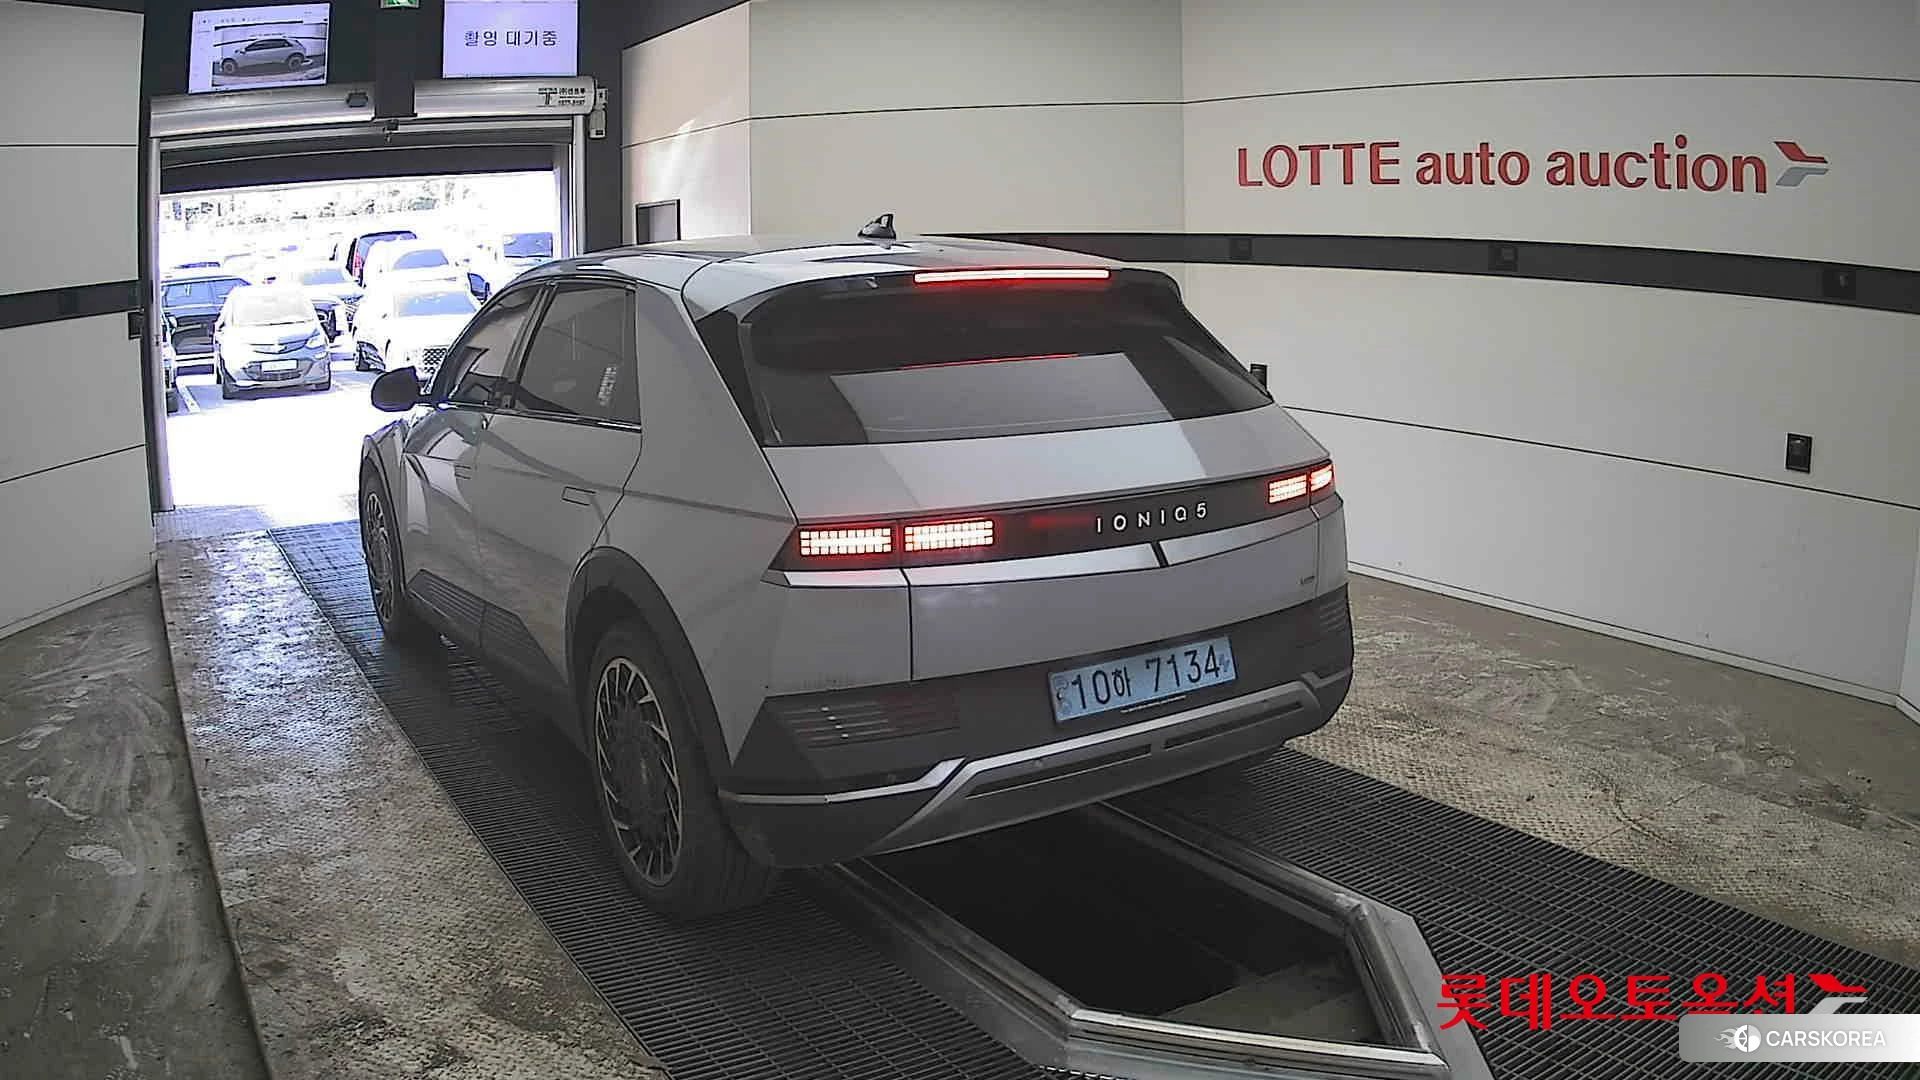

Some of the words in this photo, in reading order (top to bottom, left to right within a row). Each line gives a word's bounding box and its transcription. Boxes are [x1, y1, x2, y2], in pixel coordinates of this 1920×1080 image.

[505, 30, 557, 46] 대기중
[1237, 141, 1401, 188] LOTTE
[1415, 142, 1531, 186] auto
[1545, 134, 1768, 194] auction
[1145, 644, 1221, 693] 7134
